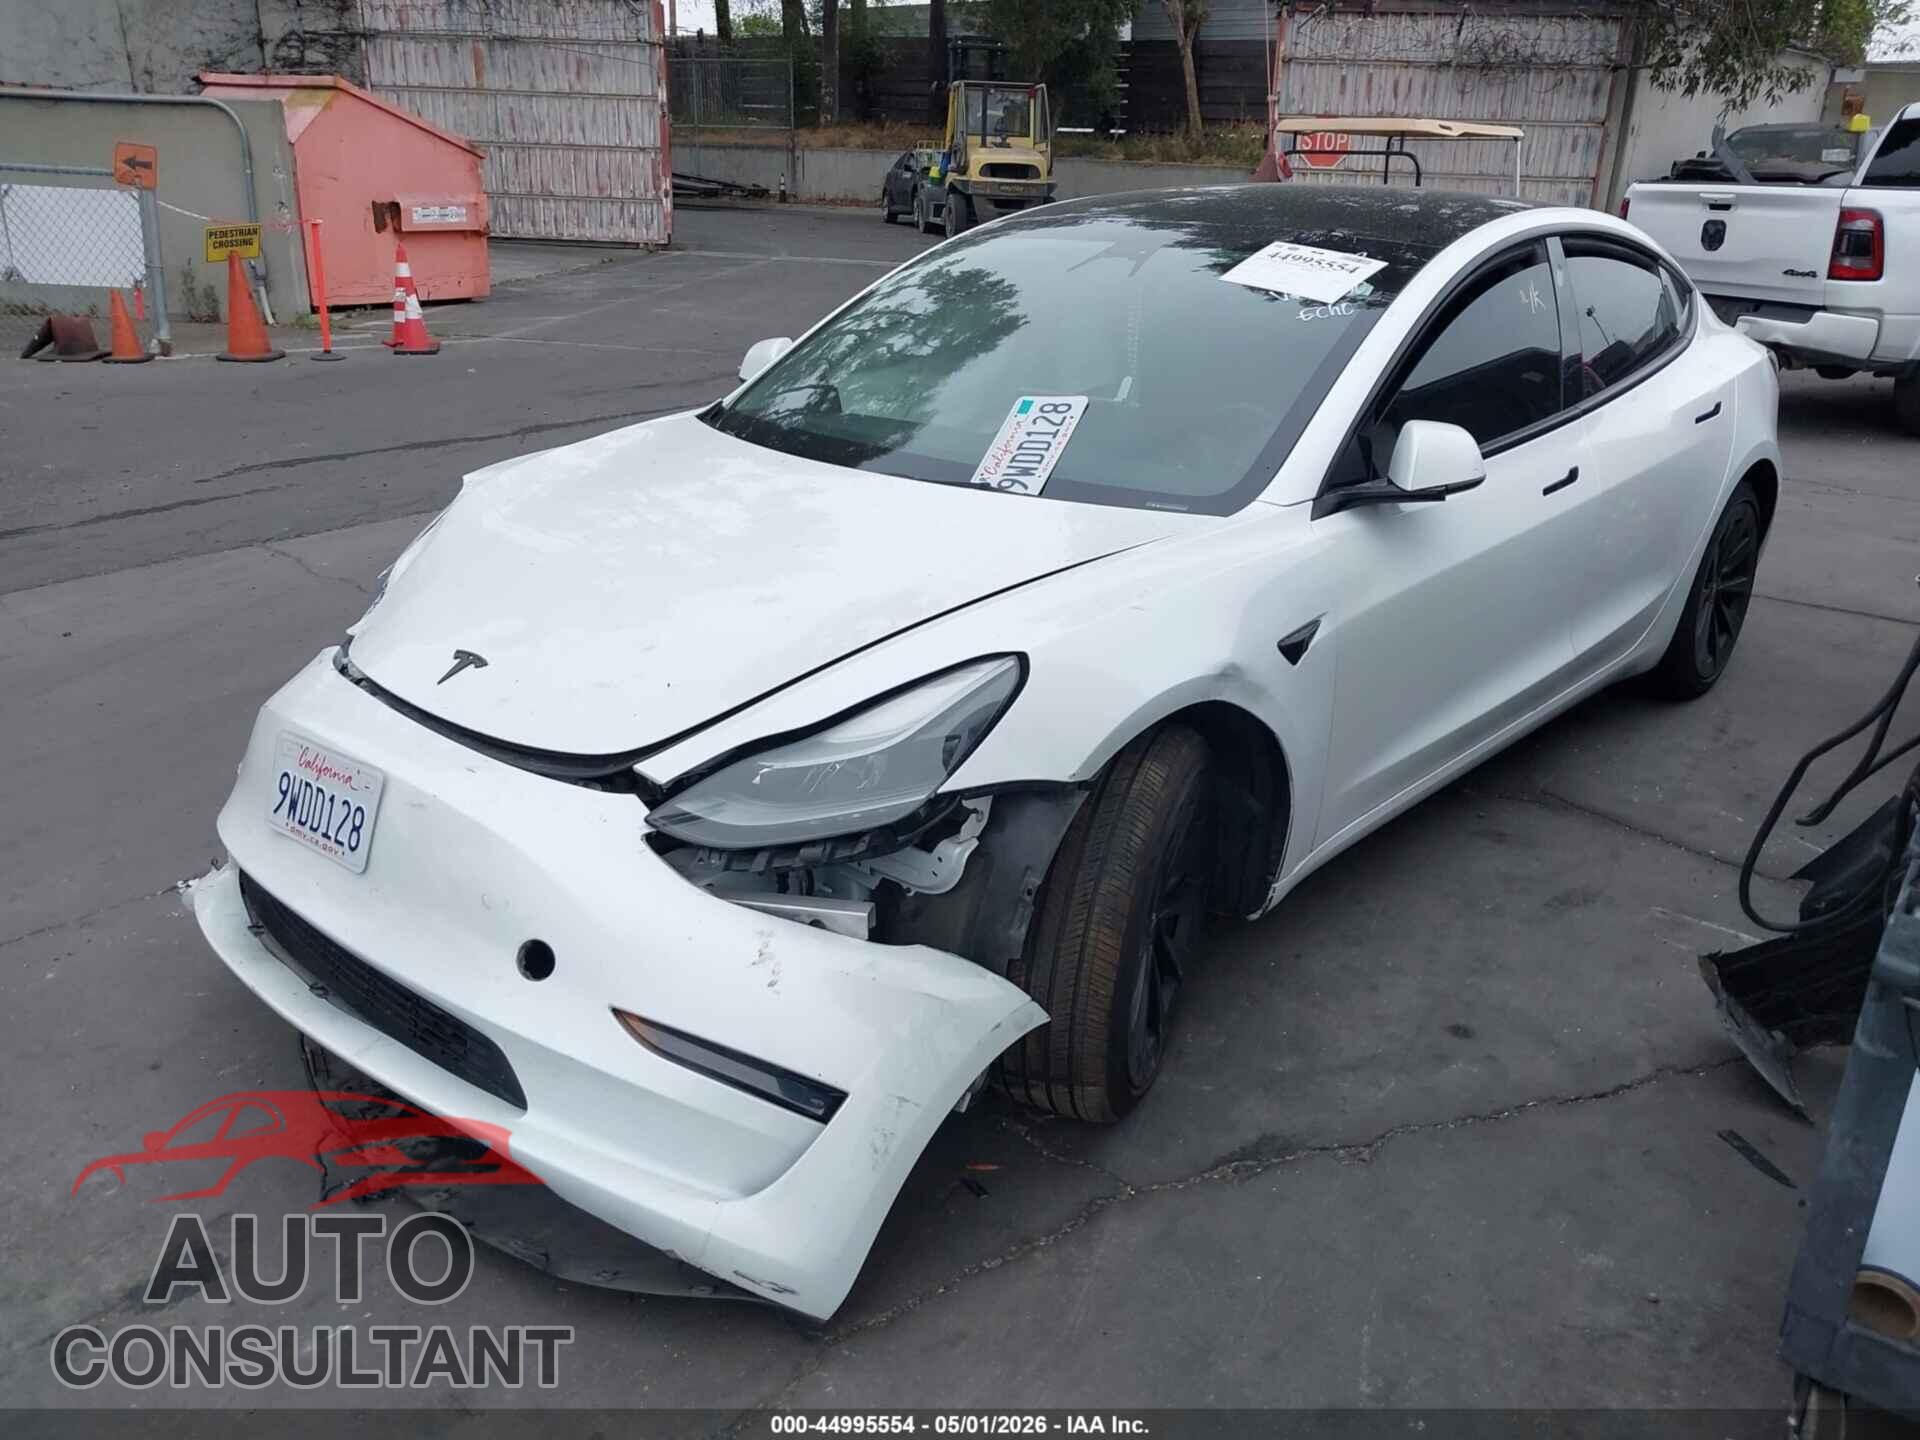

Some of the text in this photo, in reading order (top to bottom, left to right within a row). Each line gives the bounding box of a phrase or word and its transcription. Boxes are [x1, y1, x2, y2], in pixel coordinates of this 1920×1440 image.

[1302, 131, 1348, 151] STOP
[208, 227, 258, 240] PEDESTRIAN
[212, 238, 254, 249] CROSSING
[996, 402, 1073, 490] 9WDD128
[298, 744, 360, 792] California
[272, 770, 366, 853] 9WDD128
